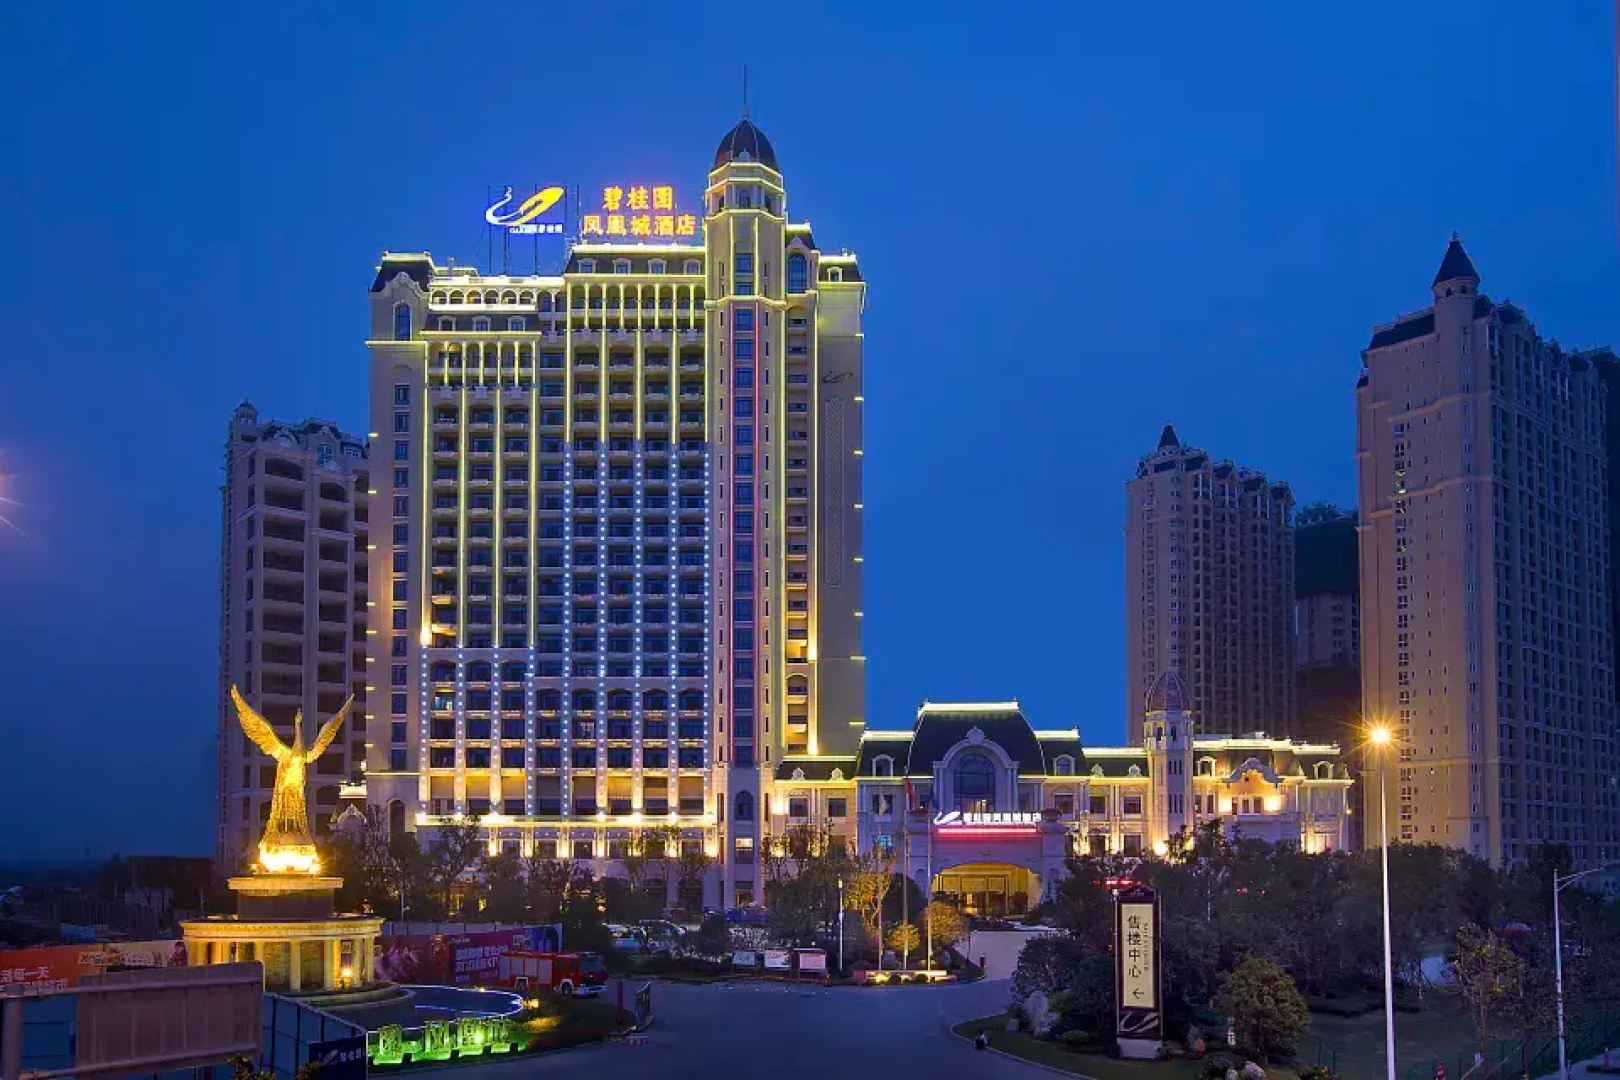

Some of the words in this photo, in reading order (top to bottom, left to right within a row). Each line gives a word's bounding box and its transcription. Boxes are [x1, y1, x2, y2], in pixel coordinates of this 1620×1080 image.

[602, 186, 673, 210] 碧桂园
[581, 214, 695, 236] 凤凰城酒店
[1126, 914, 1142, 978] 售楼中心
